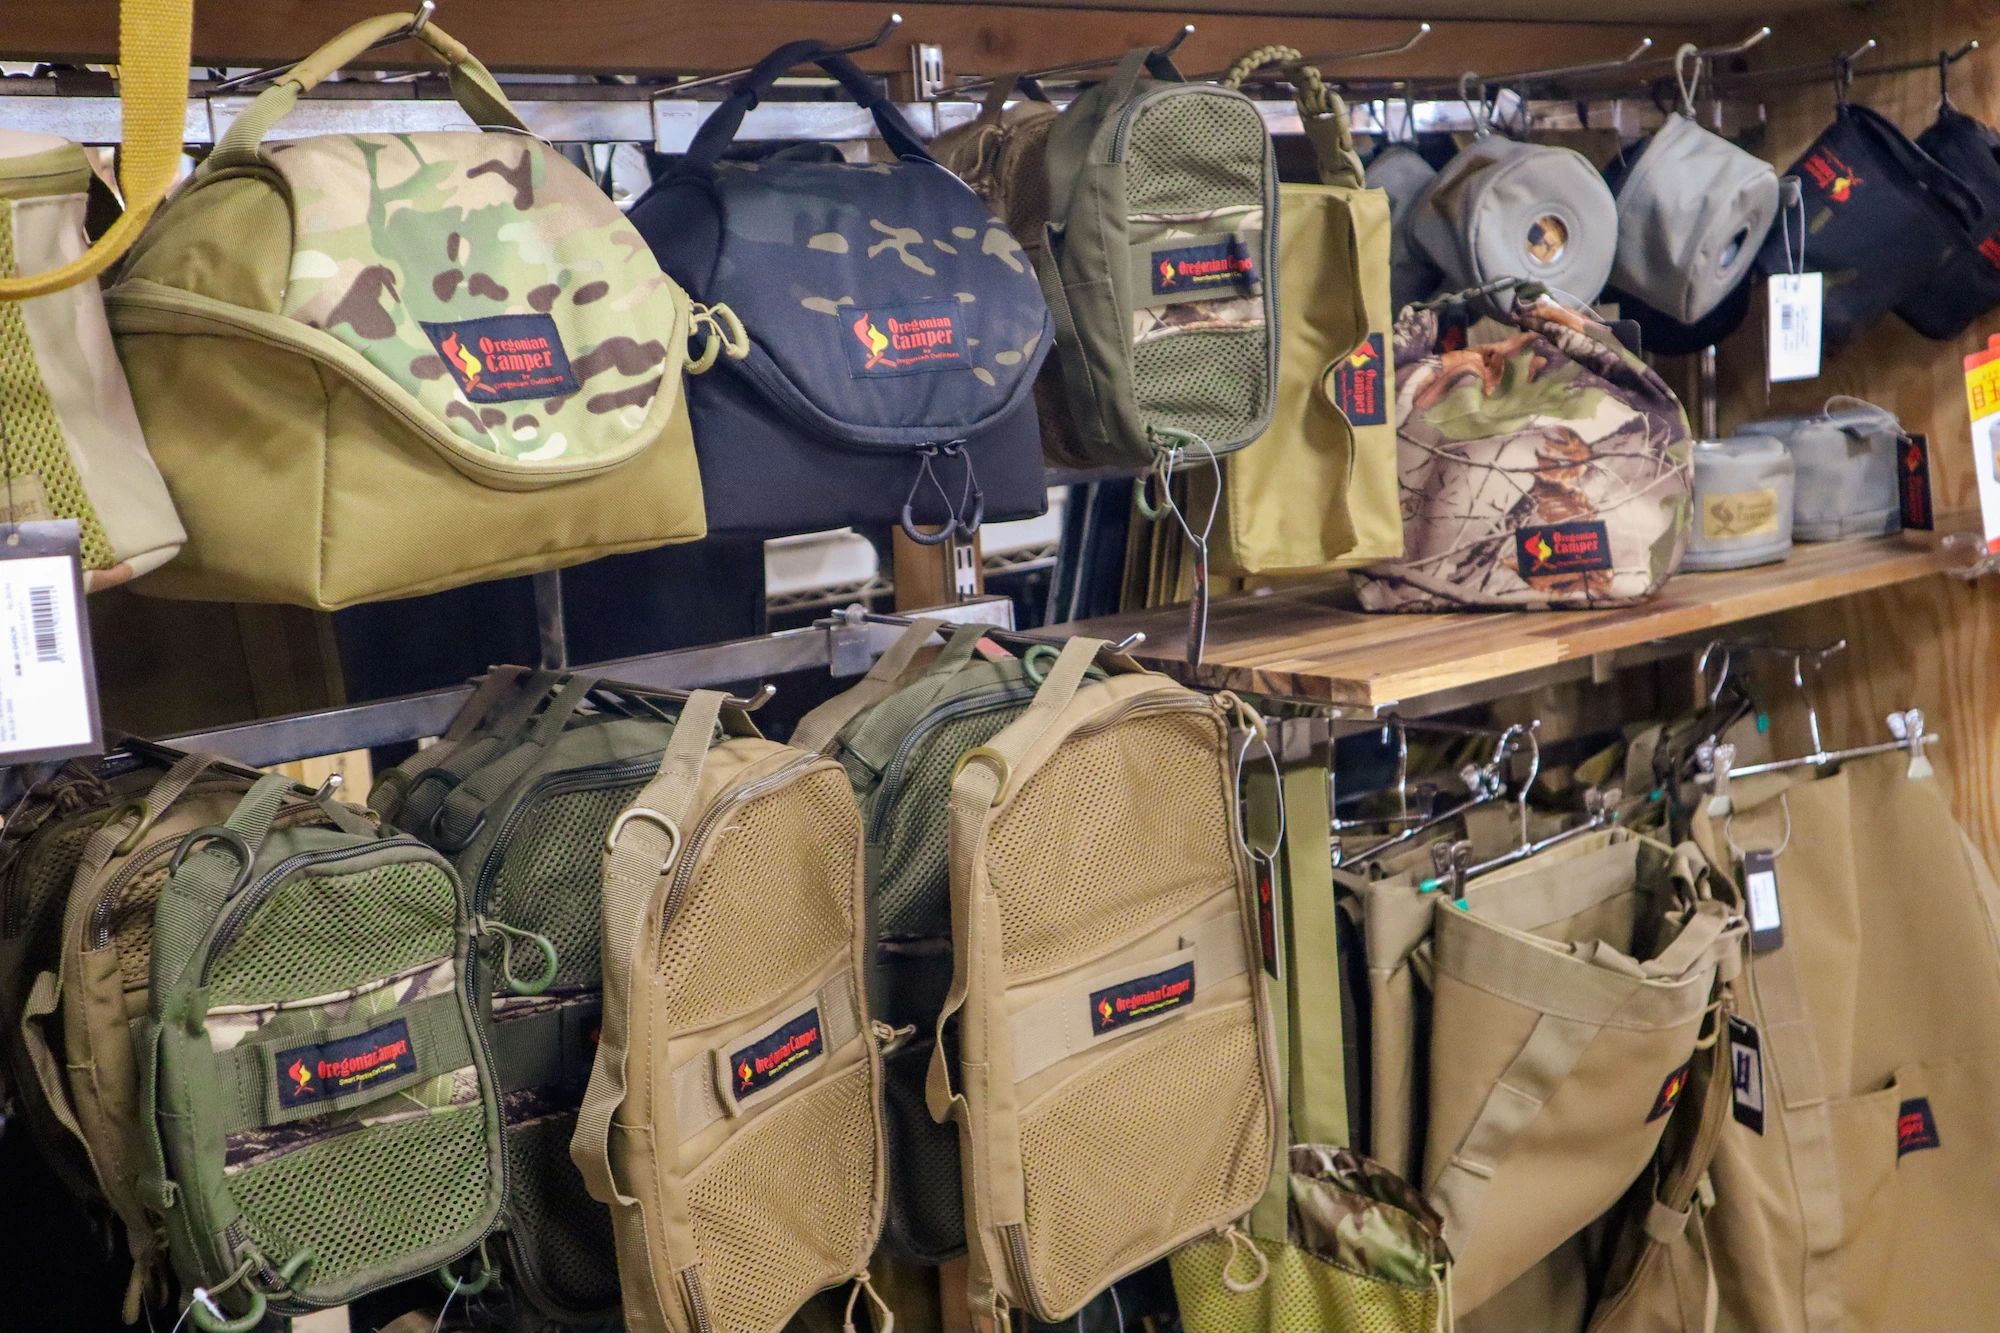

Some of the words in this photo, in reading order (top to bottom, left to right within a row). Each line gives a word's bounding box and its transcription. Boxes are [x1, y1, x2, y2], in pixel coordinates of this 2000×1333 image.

[888, 317, 952, 335] Oregonian
[479, 336, 549, 355] Oregonian
[891, 329, 953, 351] Camper
[485, 350, 552, 373] Camper
